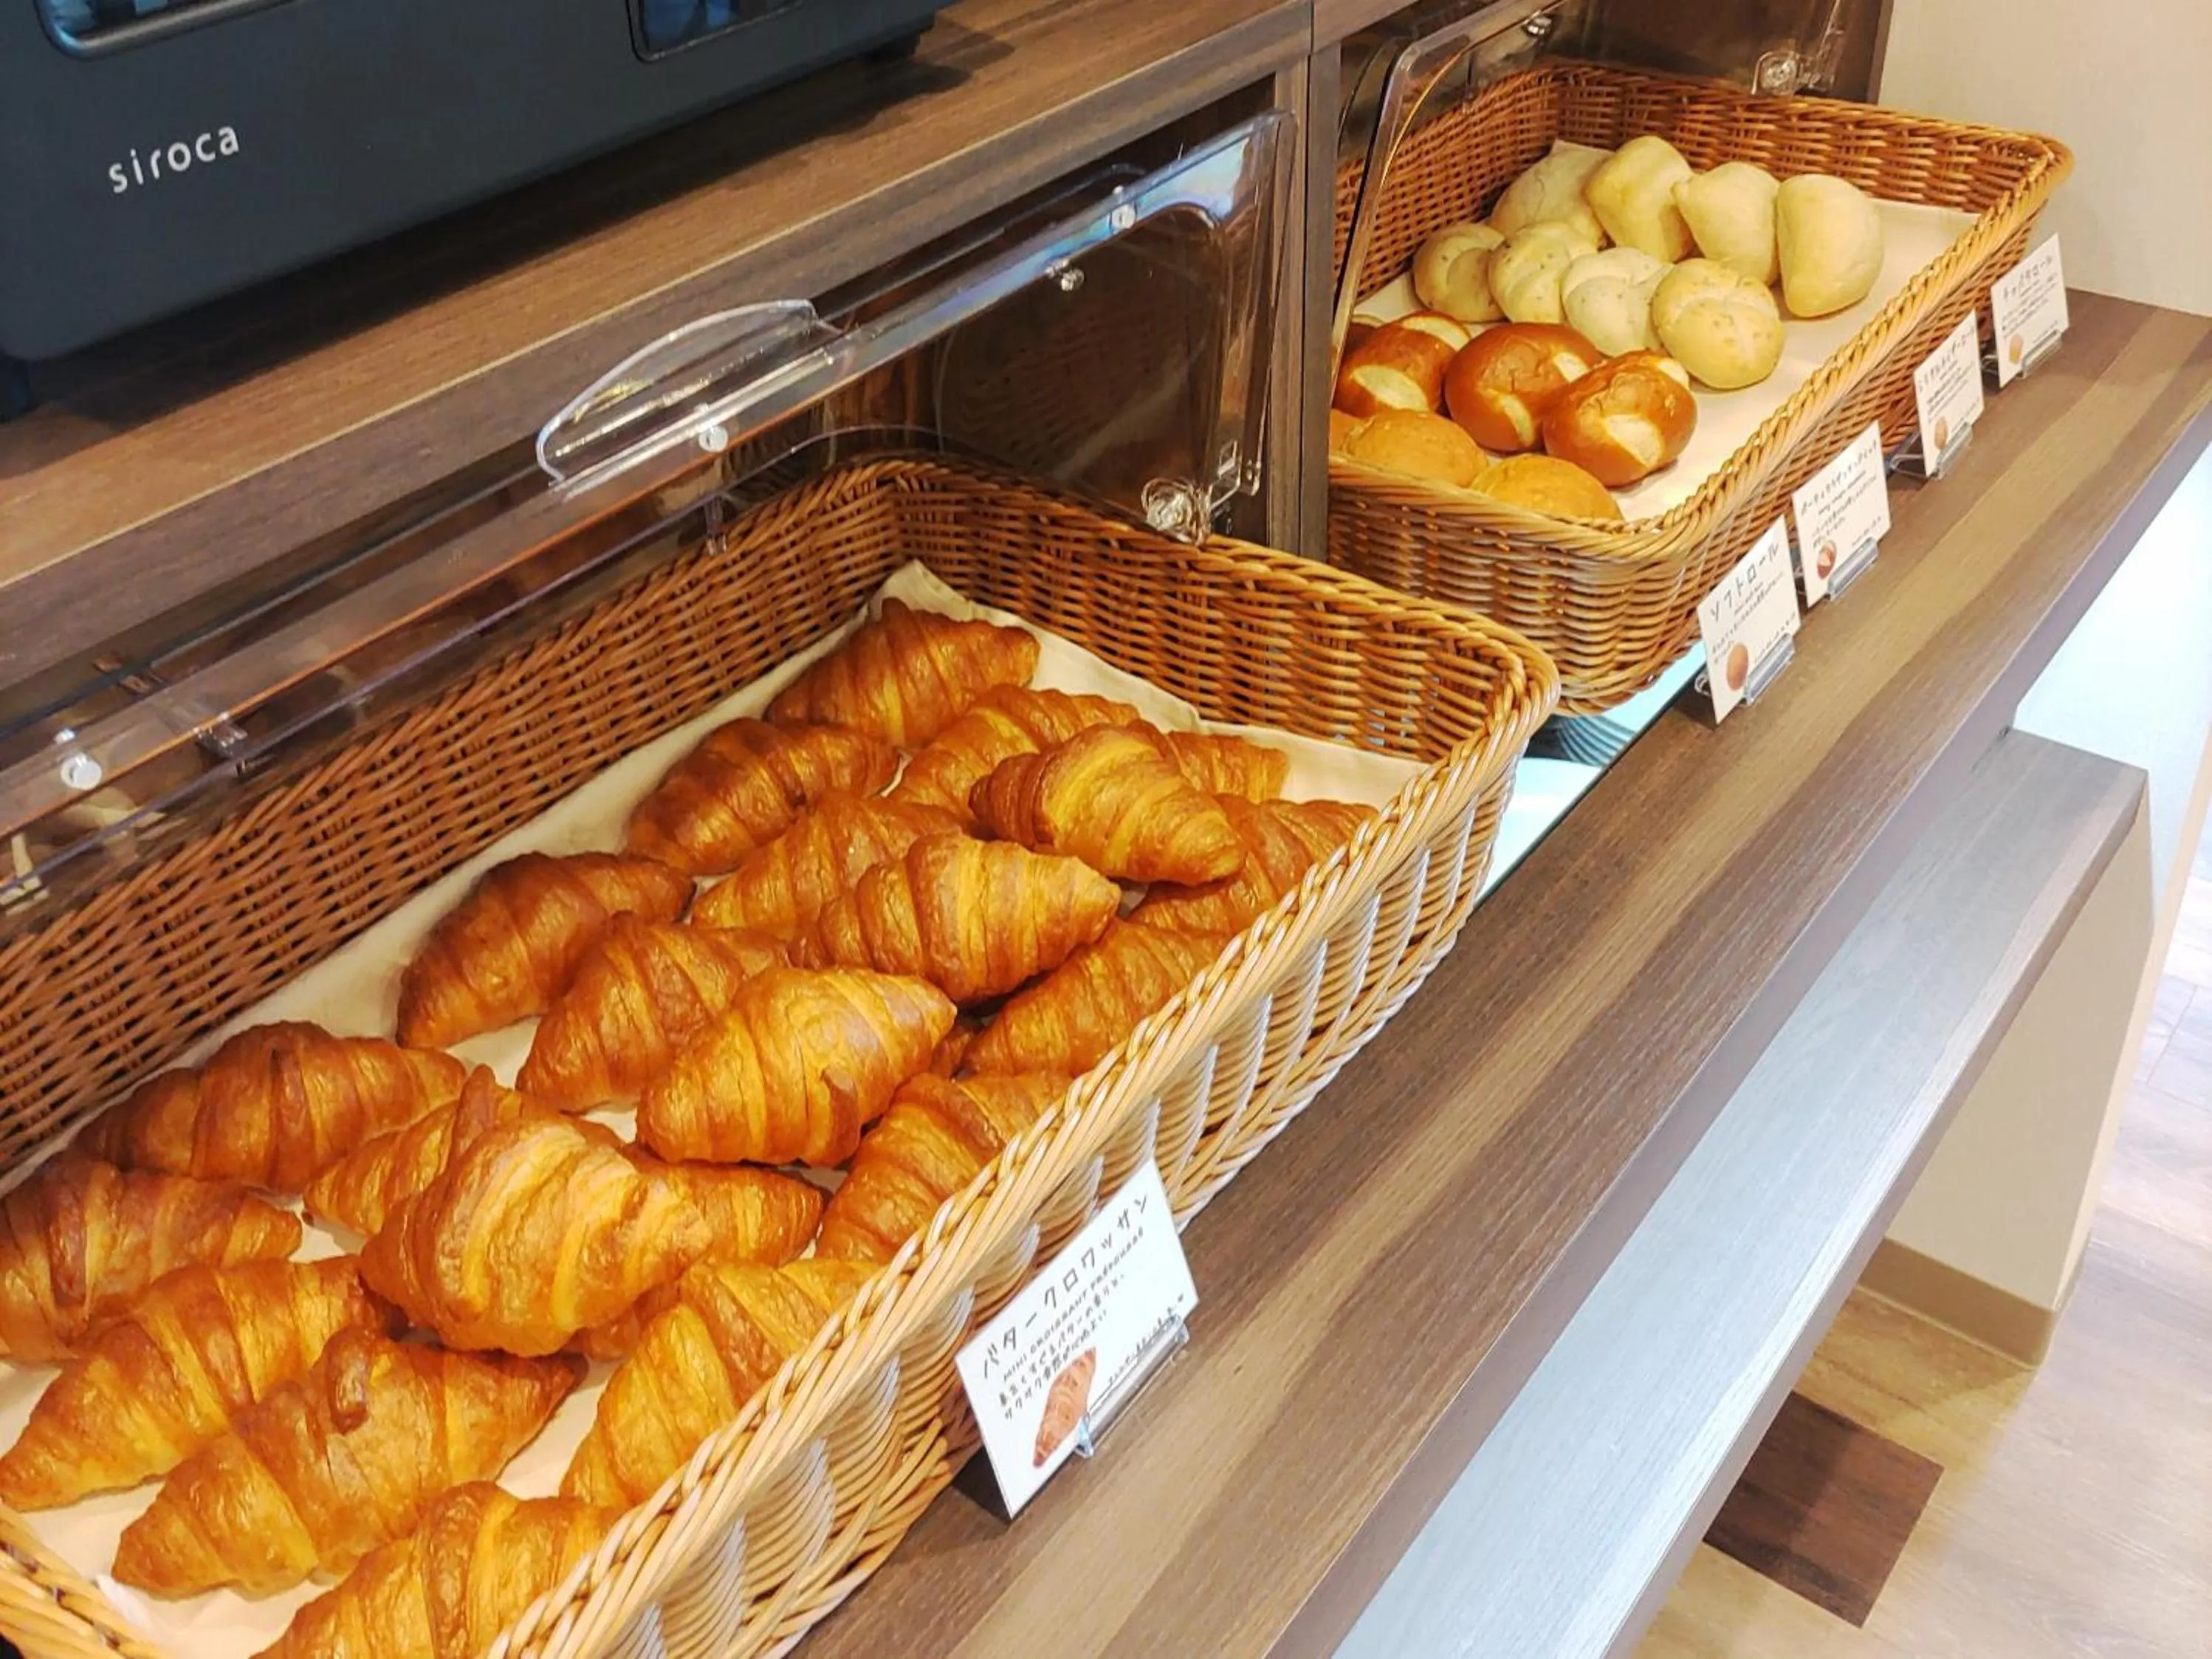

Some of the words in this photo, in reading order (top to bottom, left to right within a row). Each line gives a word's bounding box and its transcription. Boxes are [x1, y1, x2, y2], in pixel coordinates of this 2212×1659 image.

[109, 126, 240, 193] siroca
[1711, 543, 1780, 623] ソフトロール
[984, 1195, 1148, 1379] バタークロワッサン
